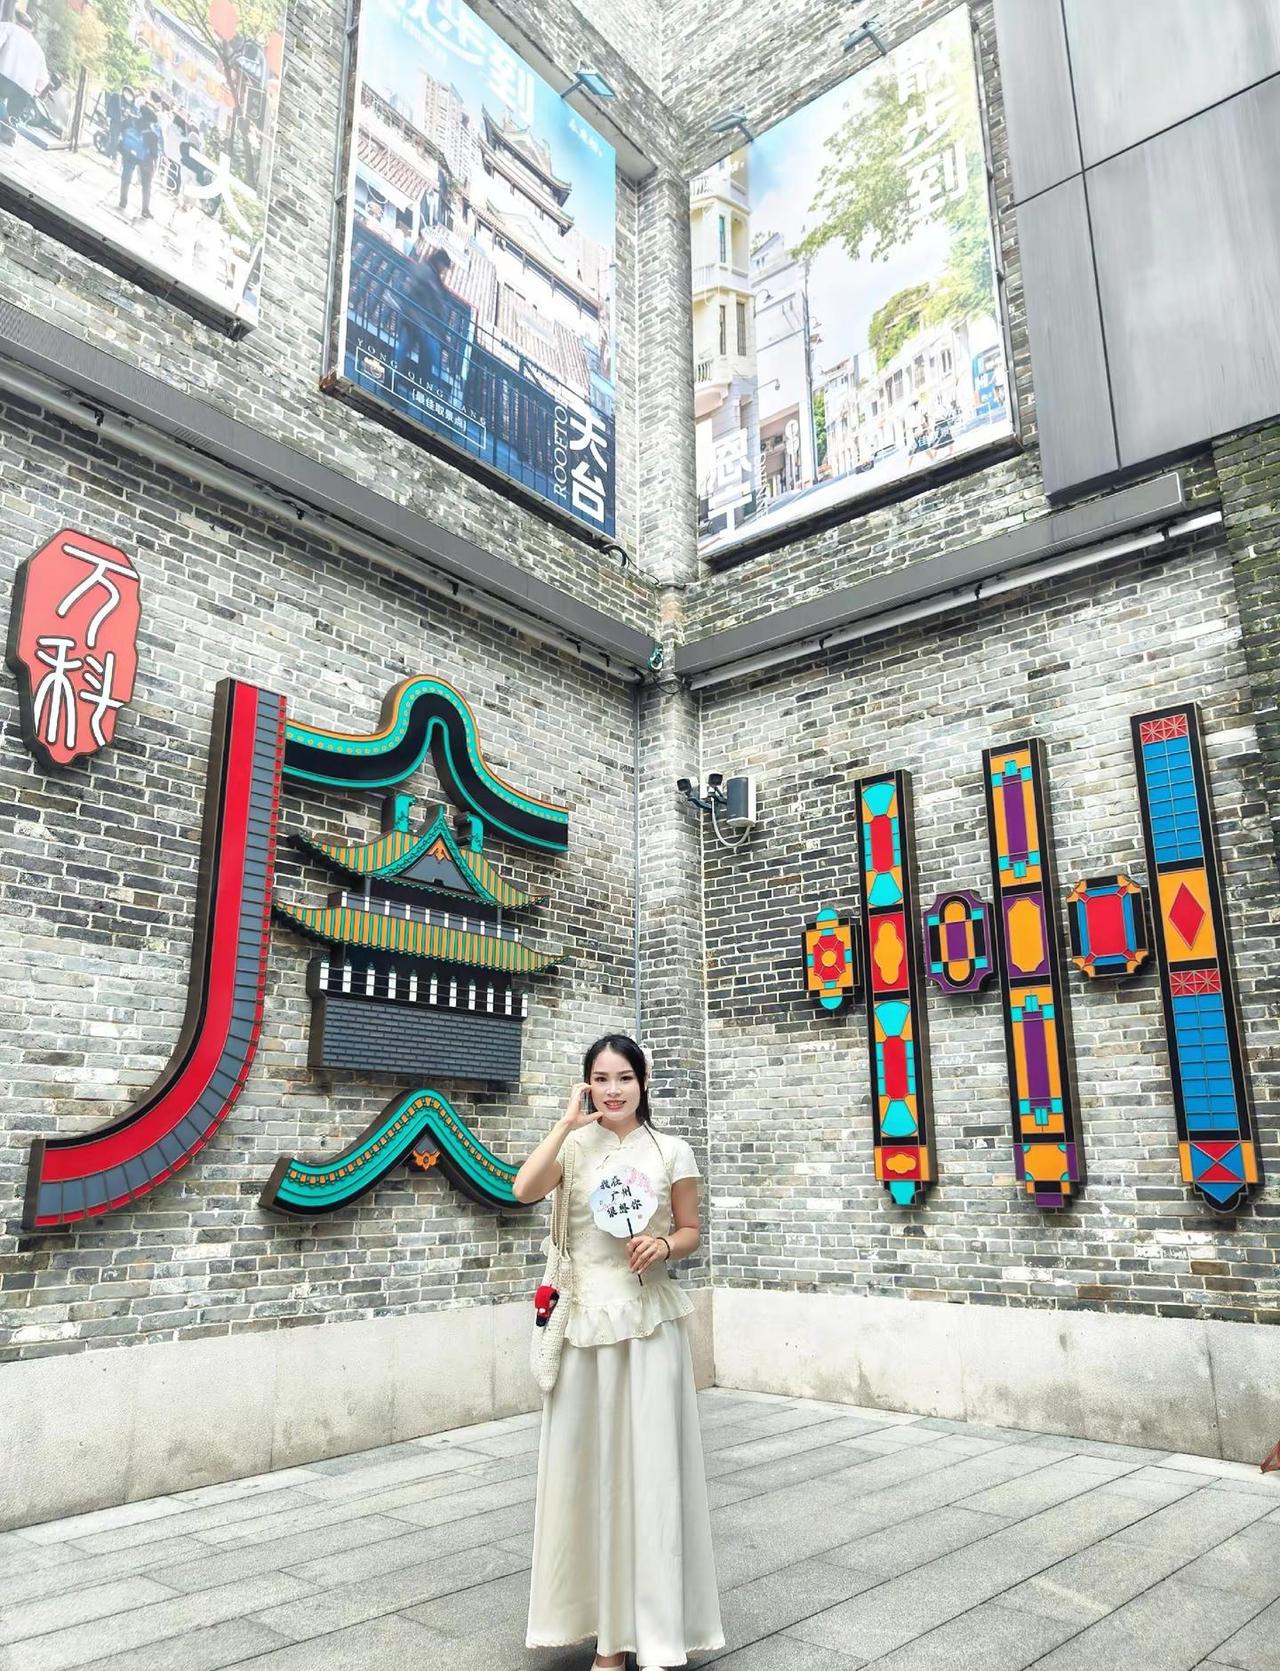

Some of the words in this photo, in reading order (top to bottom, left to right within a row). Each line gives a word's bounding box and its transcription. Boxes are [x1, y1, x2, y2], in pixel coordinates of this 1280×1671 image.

[358, 338, 398, 370] YONG
[408, 371, 444, 399] QING
[553, 393, 569, 500] ROOFTO
[569, 401, 608, 523] 天台
[33, 542, 140, 748] 万科
[600, 1175, 622, 1190] 我在
[607, 1198, 642, 1218] 很想你
[611, 1185, 632, 1202] 广州
